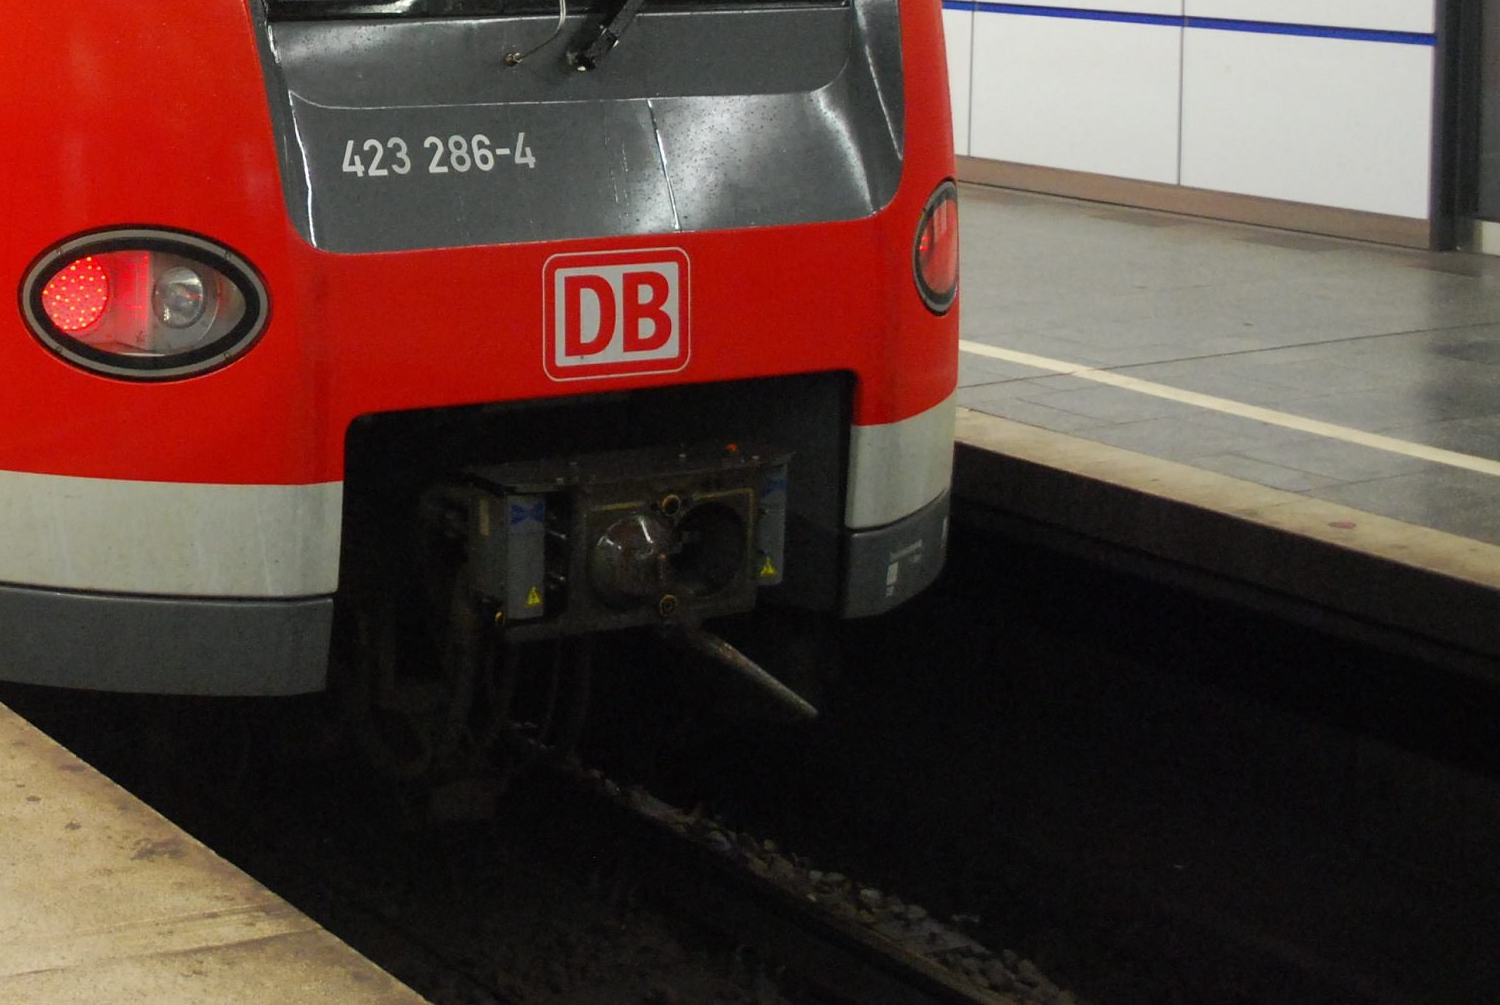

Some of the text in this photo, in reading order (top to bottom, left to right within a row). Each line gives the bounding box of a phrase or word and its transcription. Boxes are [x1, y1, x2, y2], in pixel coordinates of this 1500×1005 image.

[342, 132, 536, 177] 423 286-4
[559, 265, 676, 362] DB
